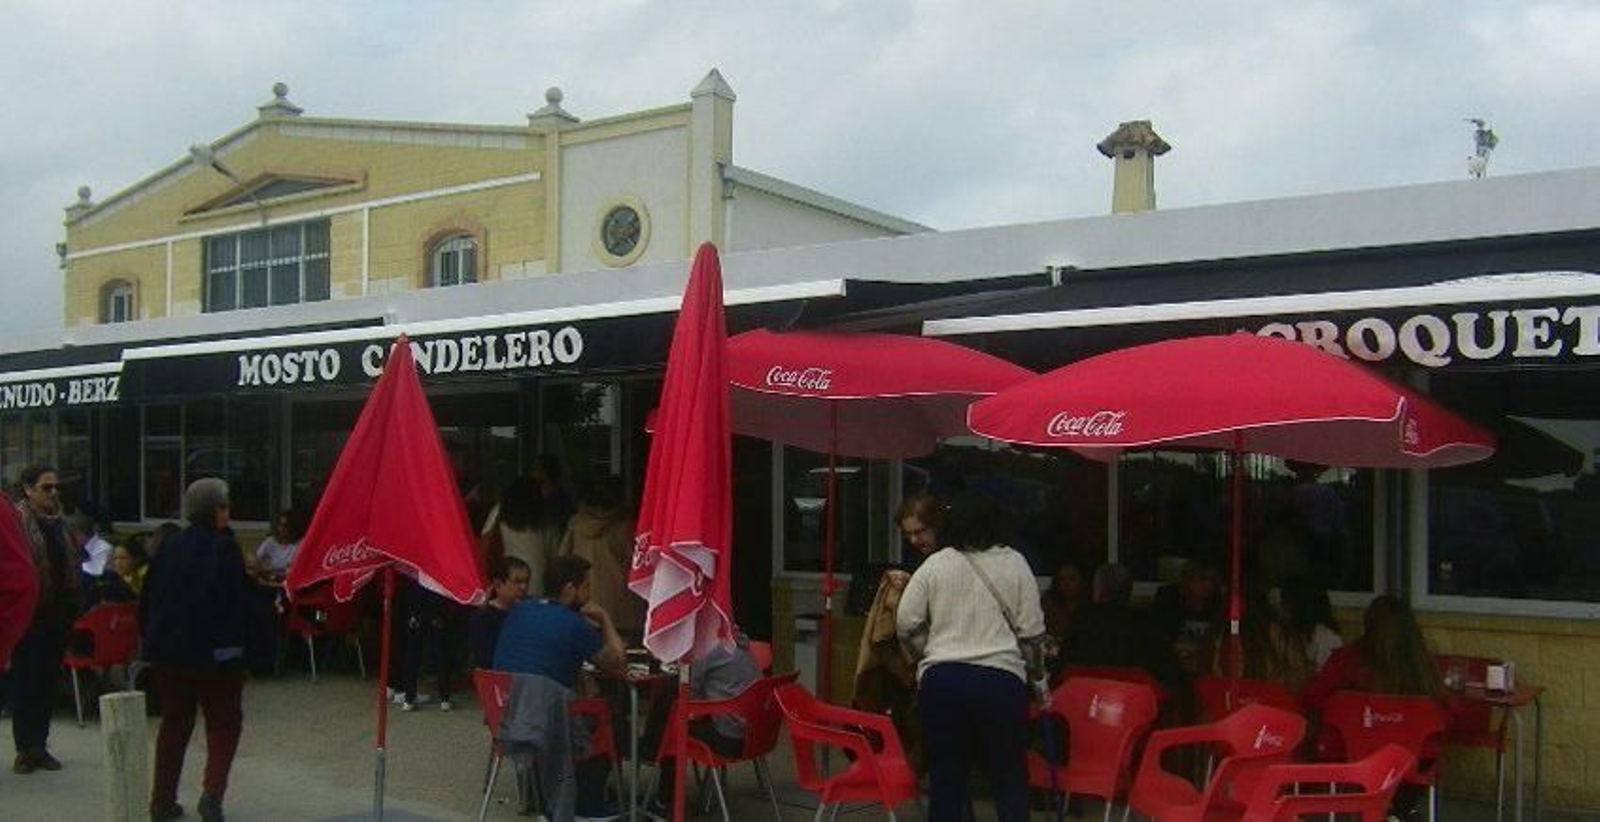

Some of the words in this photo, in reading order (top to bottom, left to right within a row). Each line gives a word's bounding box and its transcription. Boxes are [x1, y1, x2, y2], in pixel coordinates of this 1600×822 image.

[238, 348, 341, 386] MOSTO
[361, 326, 584, 377] CNDELERO
[0, 382, 56, 408] NUDO
